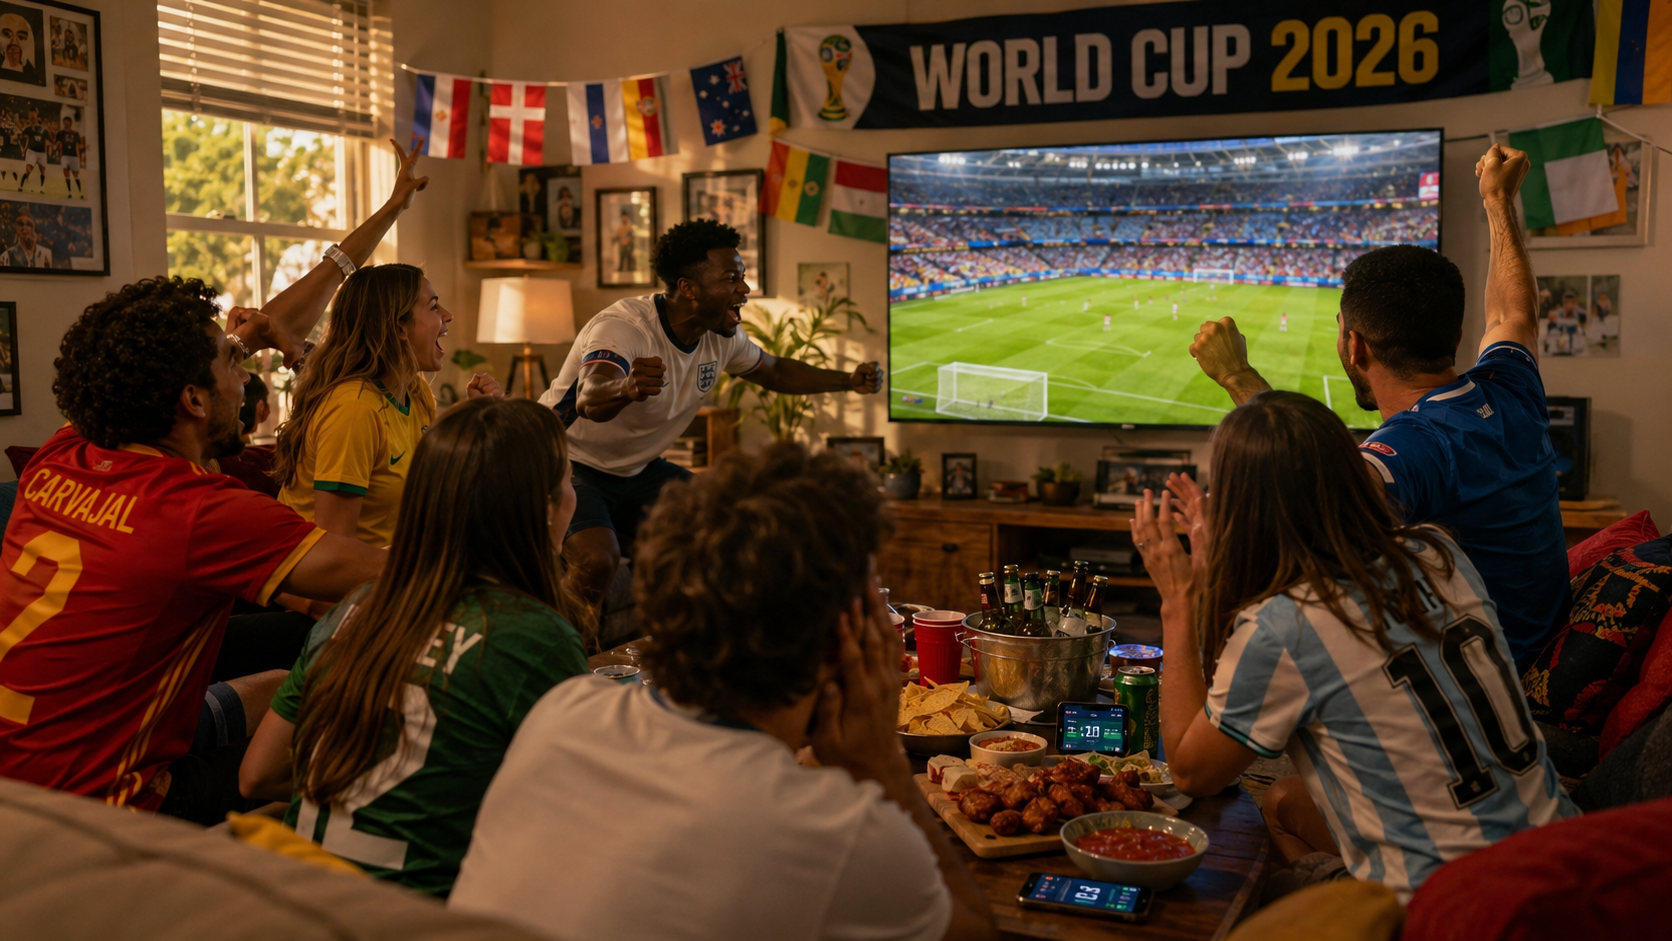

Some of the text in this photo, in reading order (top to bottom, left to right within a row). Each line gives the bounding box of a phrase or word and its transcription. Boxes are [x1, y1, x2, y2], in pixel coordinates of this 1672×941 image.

[909, 11, 1440, 111] WORLD CUP 2026
[24, 468, 137, 534] CARVAJAL
[0, 530, 83, 726] 2
[1383, 614, 1538, 809] 10
